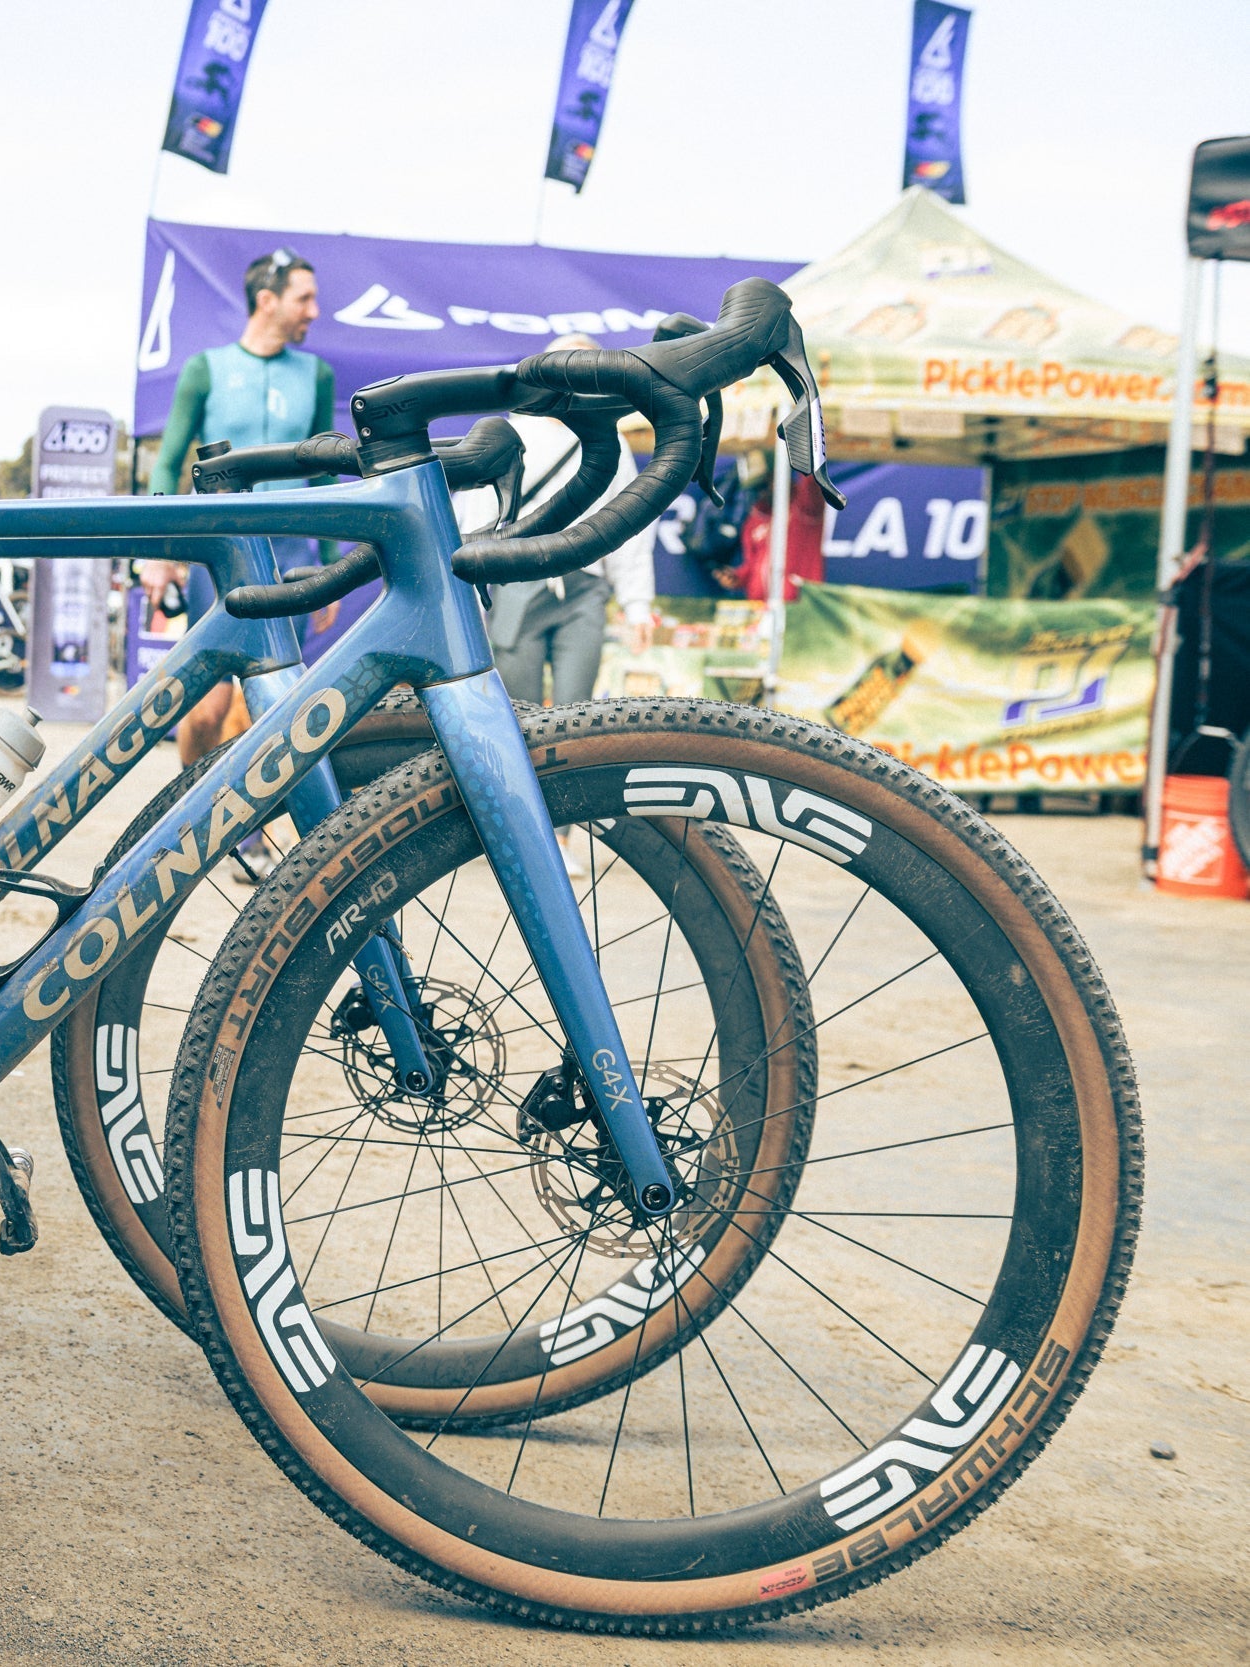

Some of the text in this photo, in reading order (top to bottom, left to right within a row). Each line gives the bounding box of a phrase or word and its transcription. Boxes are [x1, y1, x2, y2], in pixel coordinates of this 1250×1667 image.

[23, 687, 347, 1021] COLNAGO
[228, 746, 569, 1044] TNDER BURT
[325, 870, 399, 956] AR40
[623, 767, 873, 865] ENVE
[591, 1047, 634, 1112] G4-X
[228, 1168, 338, 1394] ENVE
[811, 1337, 1071, 1583] SCHWALBE
[819, 1343, 1023, 1532] ENVE
